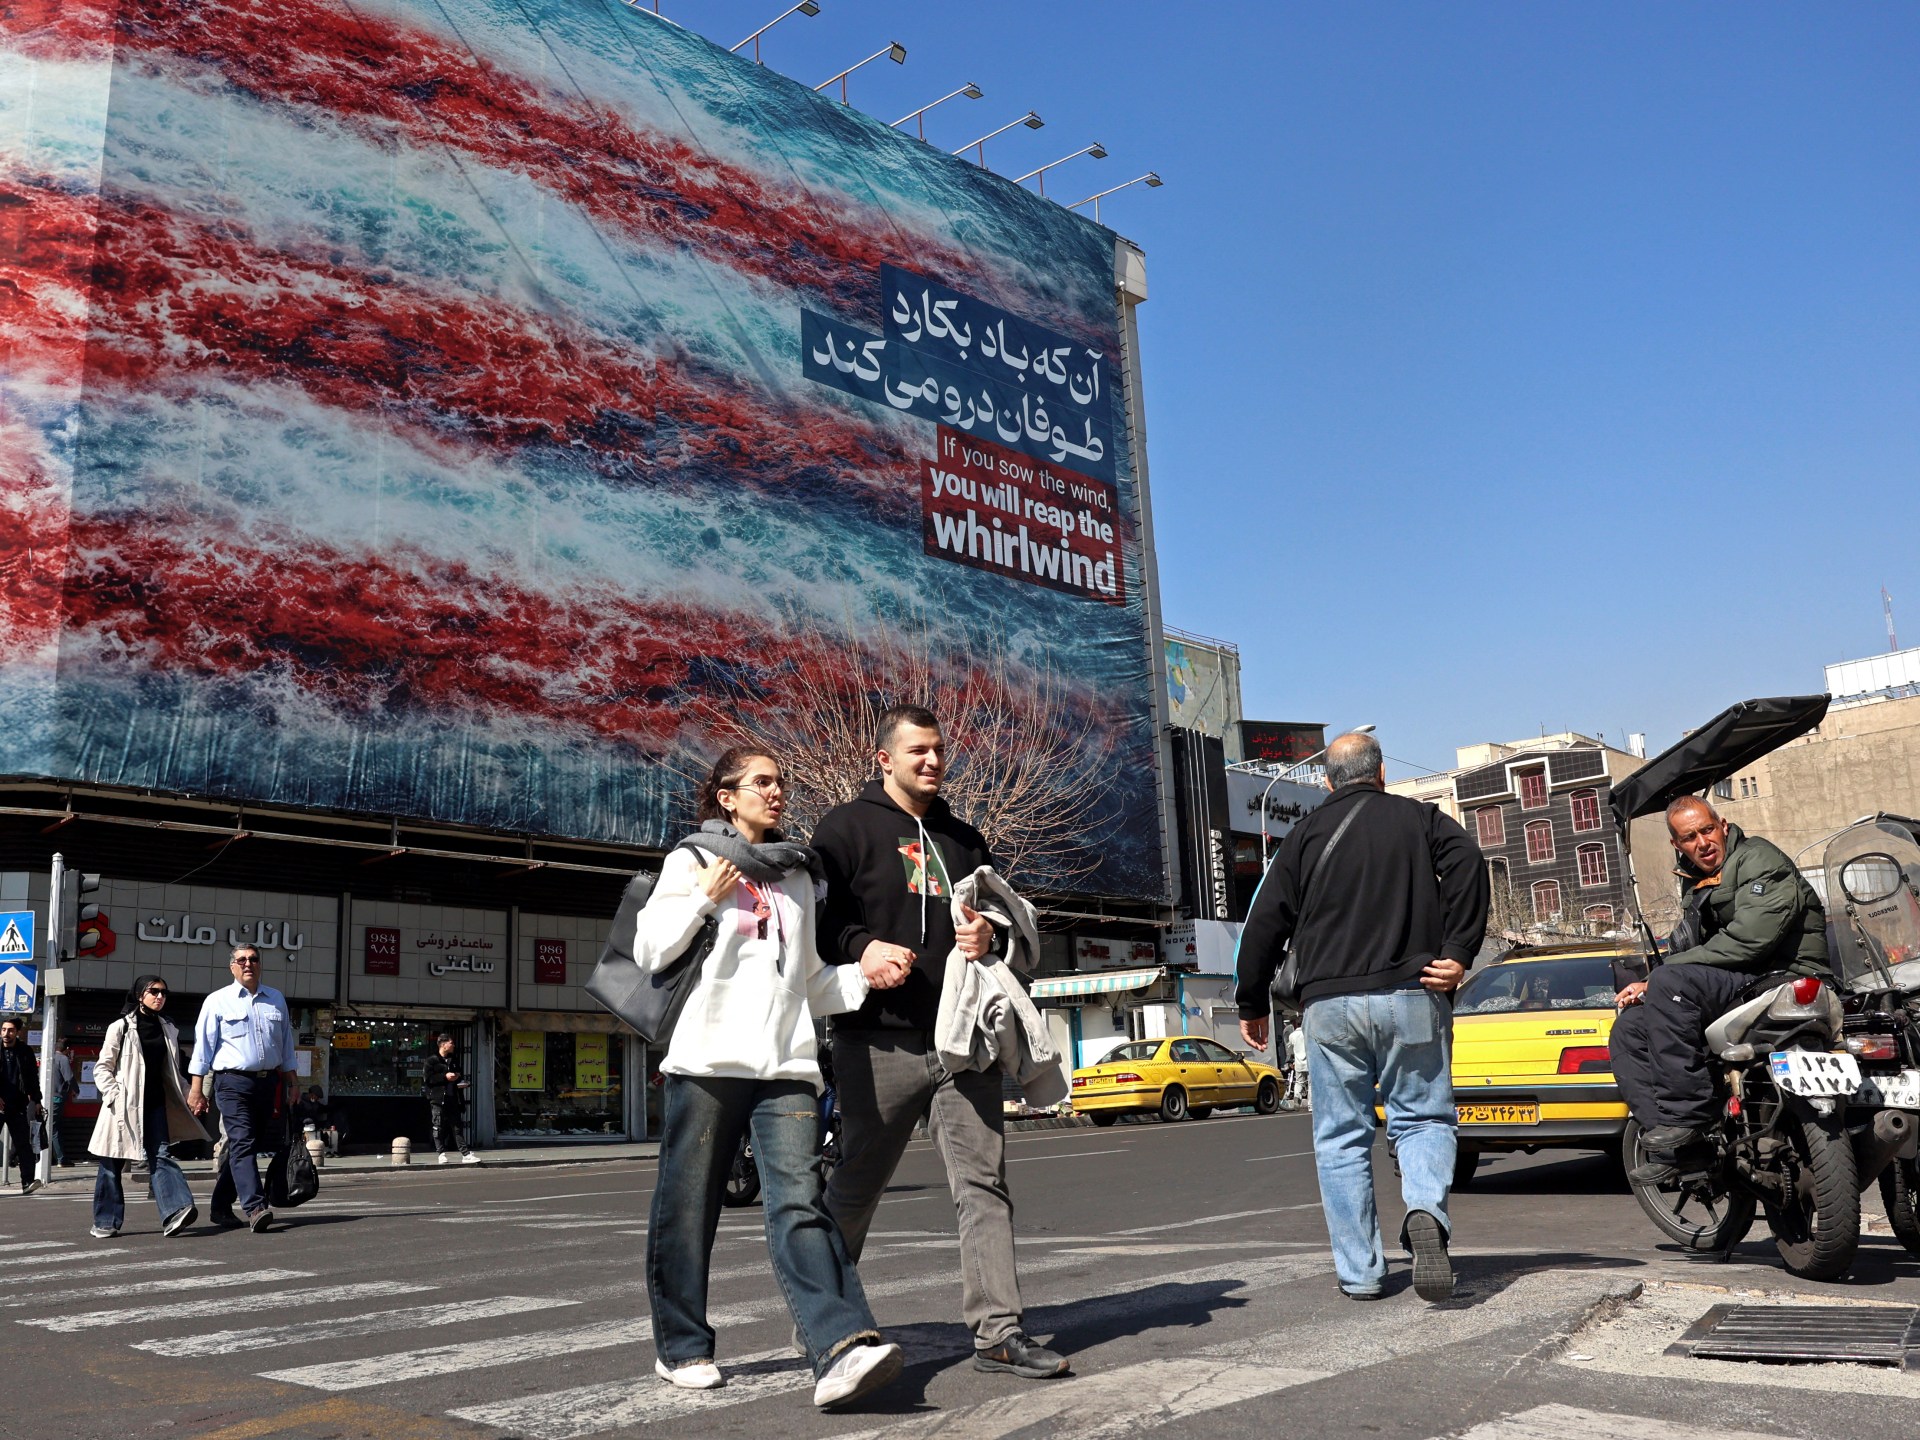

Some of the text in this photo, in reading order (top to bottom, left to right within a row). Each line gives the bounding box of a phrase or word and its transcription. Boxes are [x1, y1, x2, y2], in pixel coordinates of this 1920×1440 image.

[812, 331, 888, 382] کند
[892, 289, 1103, 405] آن که باد بکارد
[940, 389, 994, 430] درو
[995, 393, 1104, 463] طوفان
[944, 436, 1111, 513] If you sow the wind,
[929, 467, 1114, 544] you will reap the
[931, 509, 1117, 596] whirlwind
[1210, 829, 1228, 919] SAMSUNG
[138, 914, 217, 945] ملت
[370, 933, 397, 944] 984
[416, 933, 494, 950] ساعت فروشی
[539, 944, 563, 955] 986
[1165, 936, 1196, 945] NOKIA
[429, 954, 495, 976] ساعتی
[1518, 1109, 1534, 1121] ۳۳
